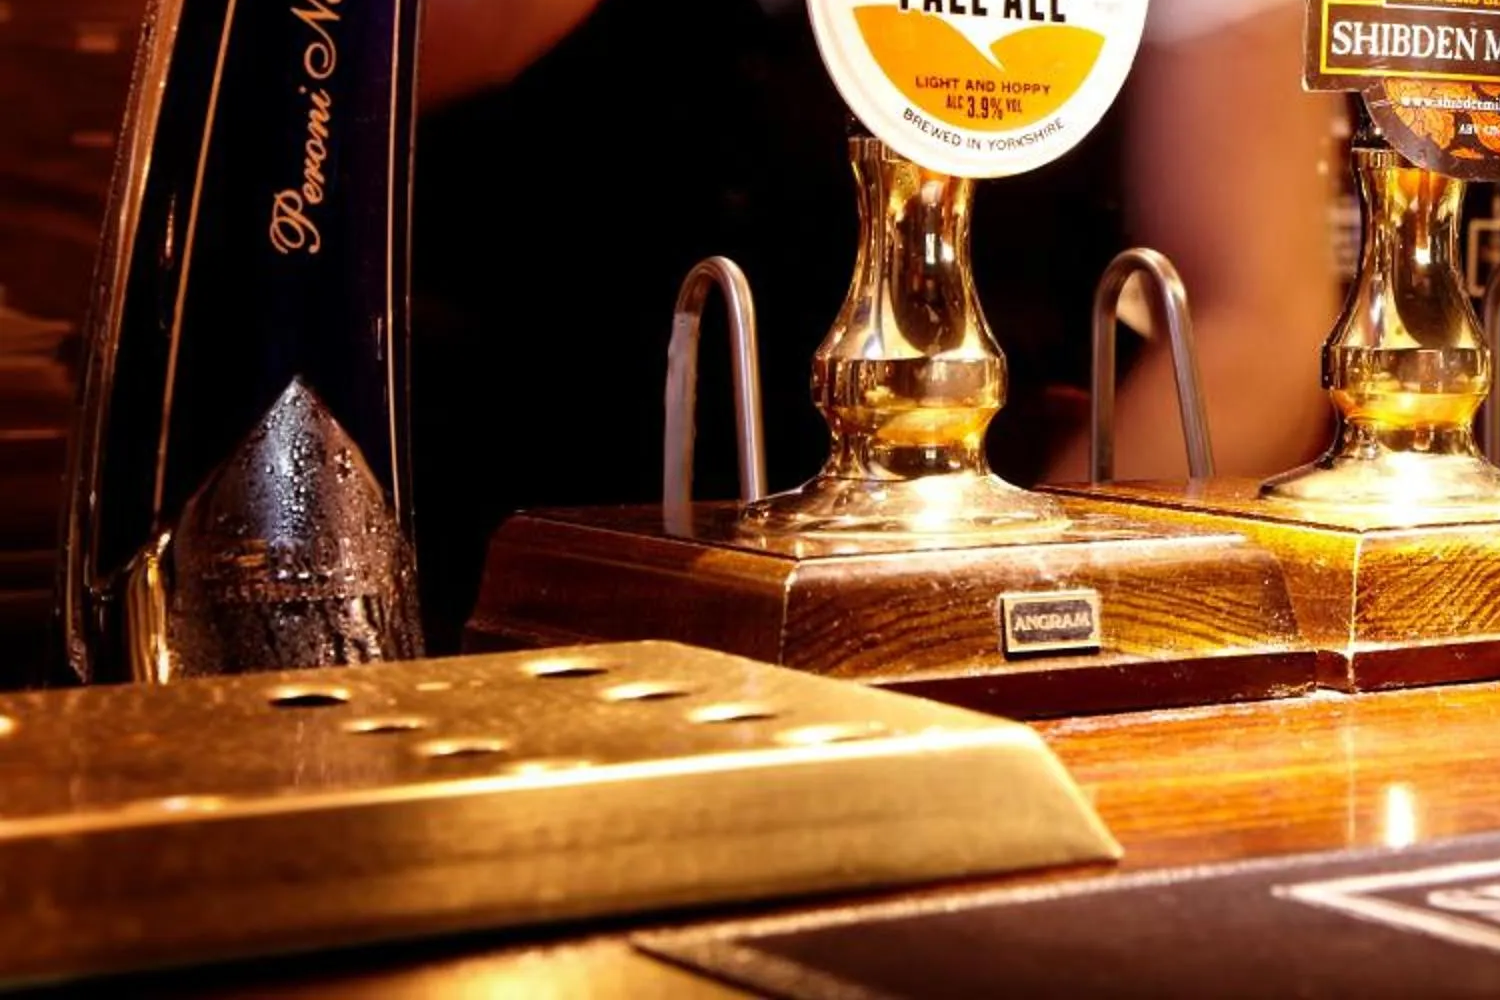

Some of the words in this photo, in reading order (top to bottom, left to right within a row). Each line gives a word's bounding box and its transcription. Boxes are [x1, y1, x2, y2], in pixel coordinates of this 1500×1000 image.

[1331, 20, 1476, 61] SHIBDEN
[915, 75, 960, 89] LIGHT
[965, 79, 996, 92] AND
[1002, 81, 1050, 95] HOPPY
[946, 95, 964, 110] ALC
[967, 95, 1003, 120] 3.9%
[1006, 98, 1022, 113] VOL
[903, 108, 962, 147] BREWED
[967, 137, 981, 150] IN
[988, 117, 1065, 151] YORKSHIRE
[269, 87, 331, 254] Peroni
[1014, 612, 1091, 632] ANGRAM
